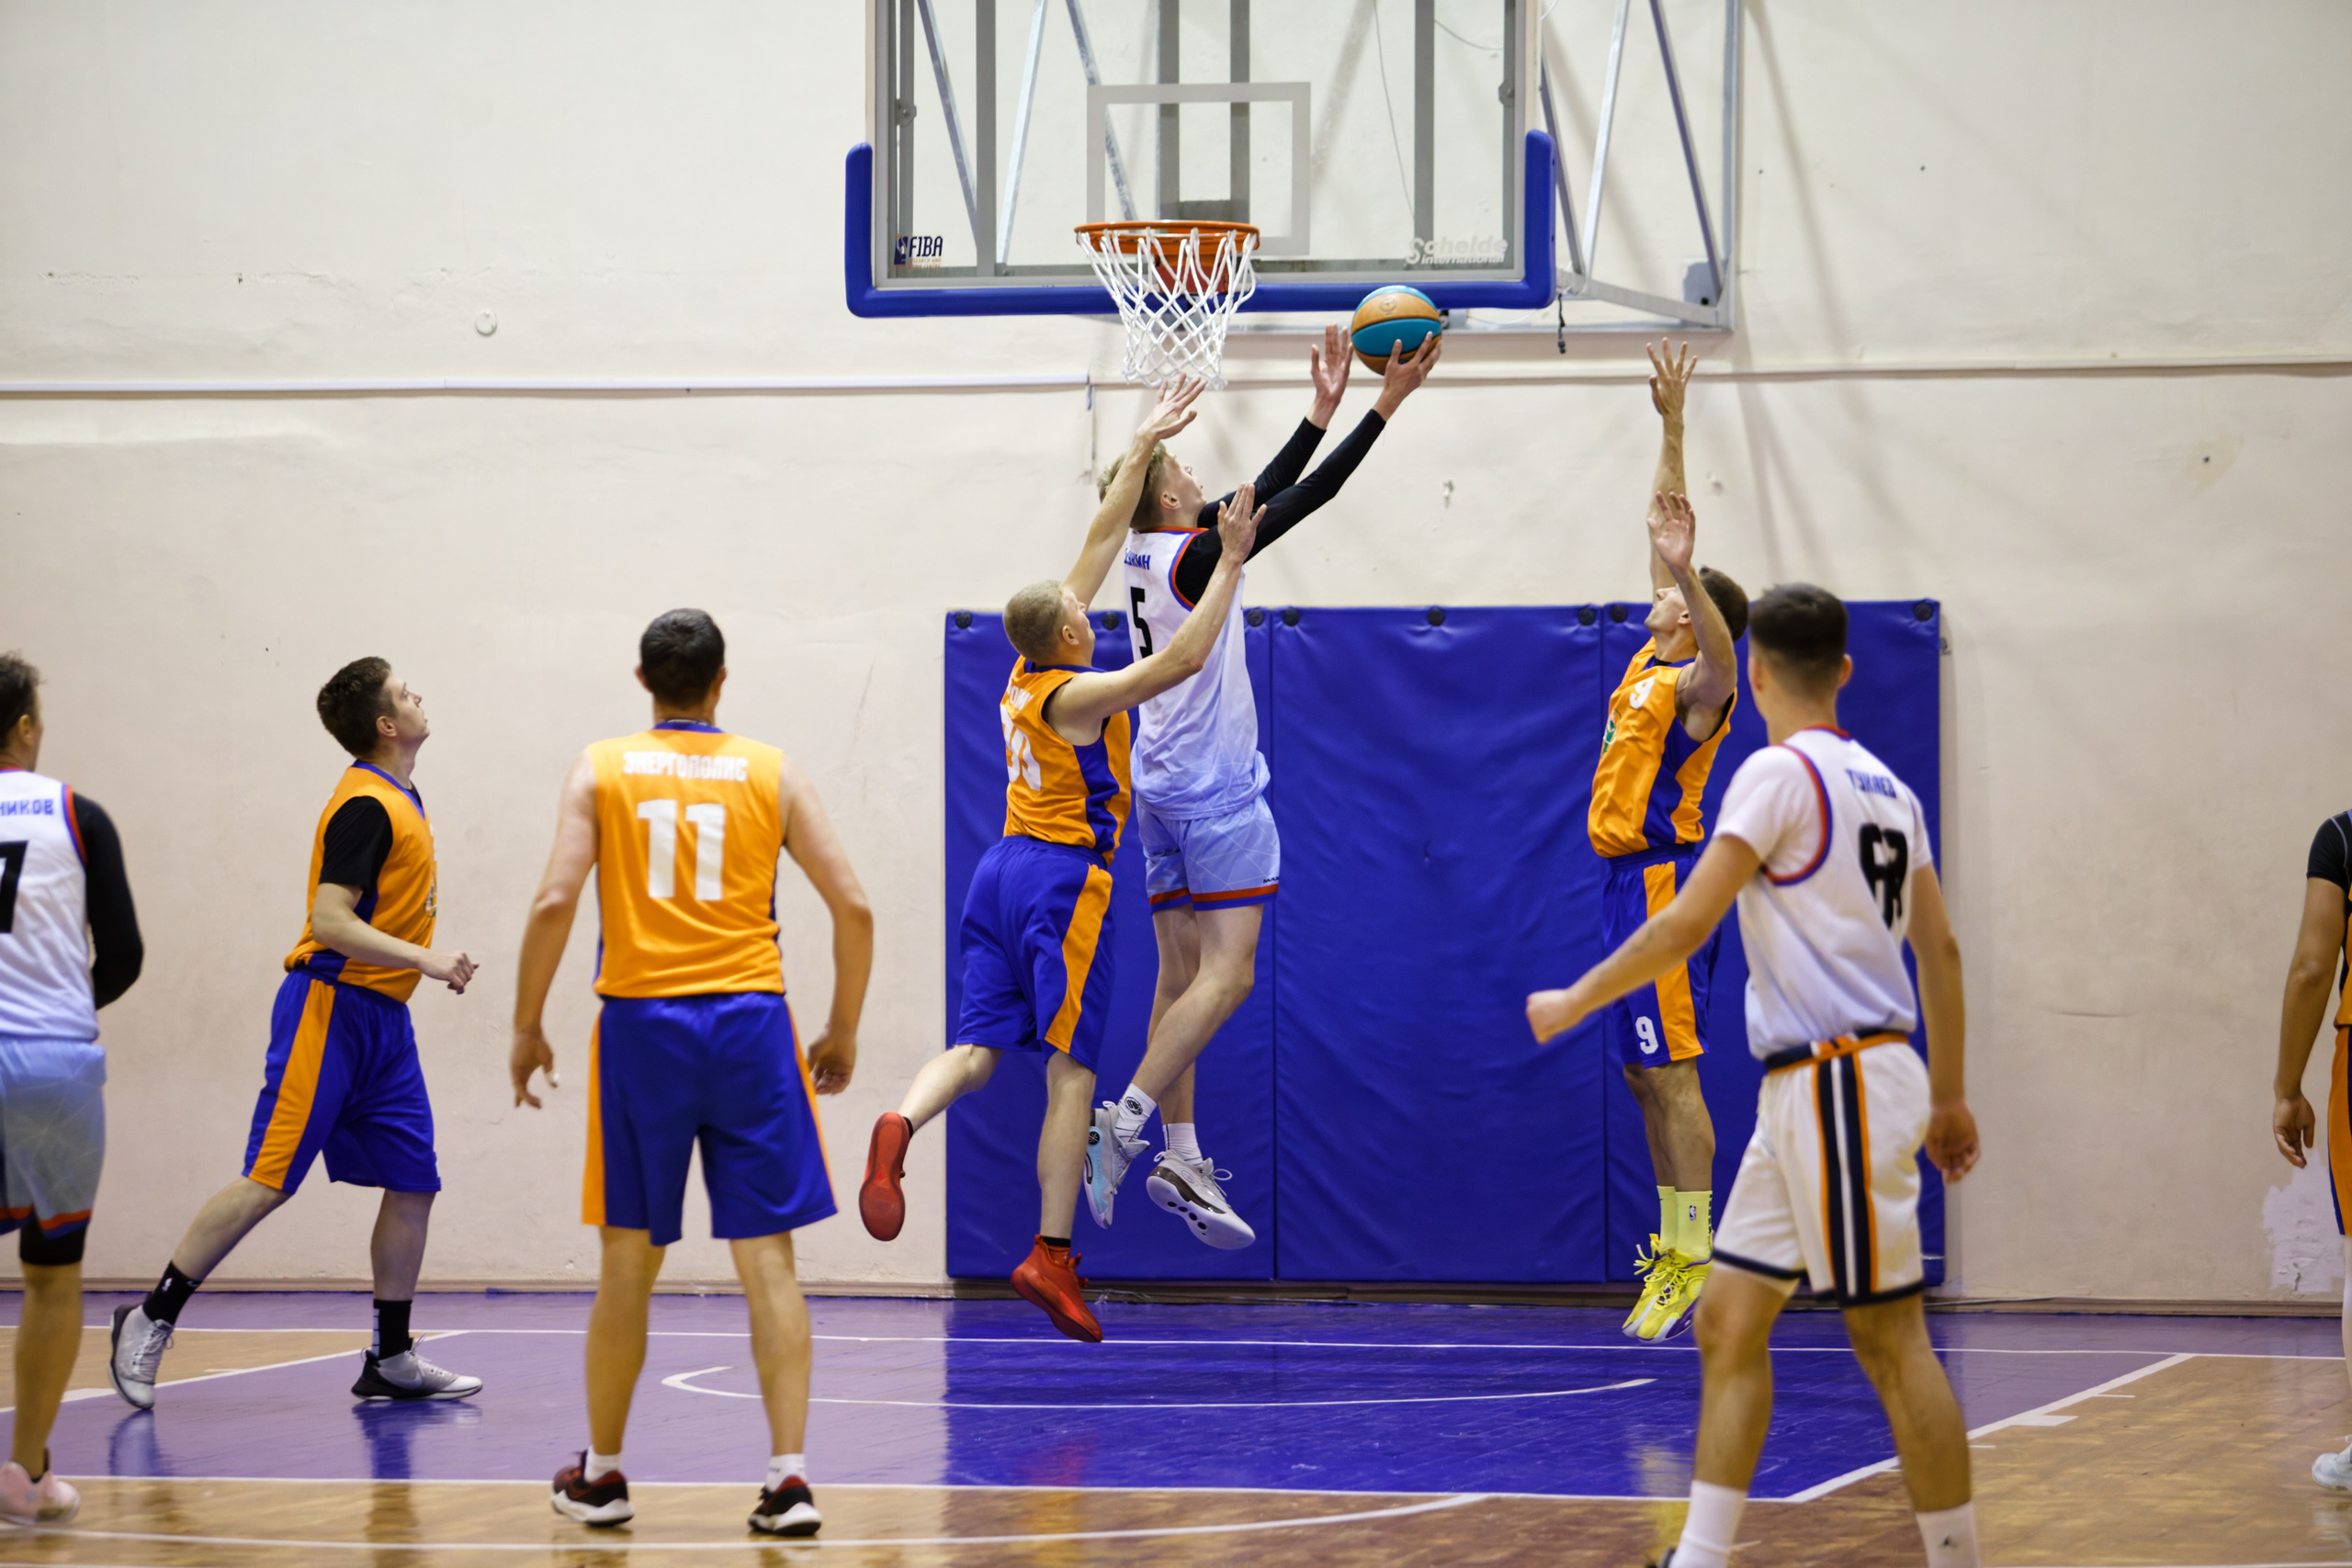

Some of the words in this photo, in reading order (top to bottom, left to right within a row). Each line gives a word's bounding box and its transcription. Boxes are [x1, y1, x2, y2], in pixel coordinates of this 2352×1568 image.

[909, 235, 944, 258] FIBA
[1405, 237, 1509, 265] Schelde
[1130, 586, 1153, 660] 5
[1629, 675, 1656, 709] 9
[637, 798, 725, 901] 11
[1634, 1015, 1659, 1055] 9
